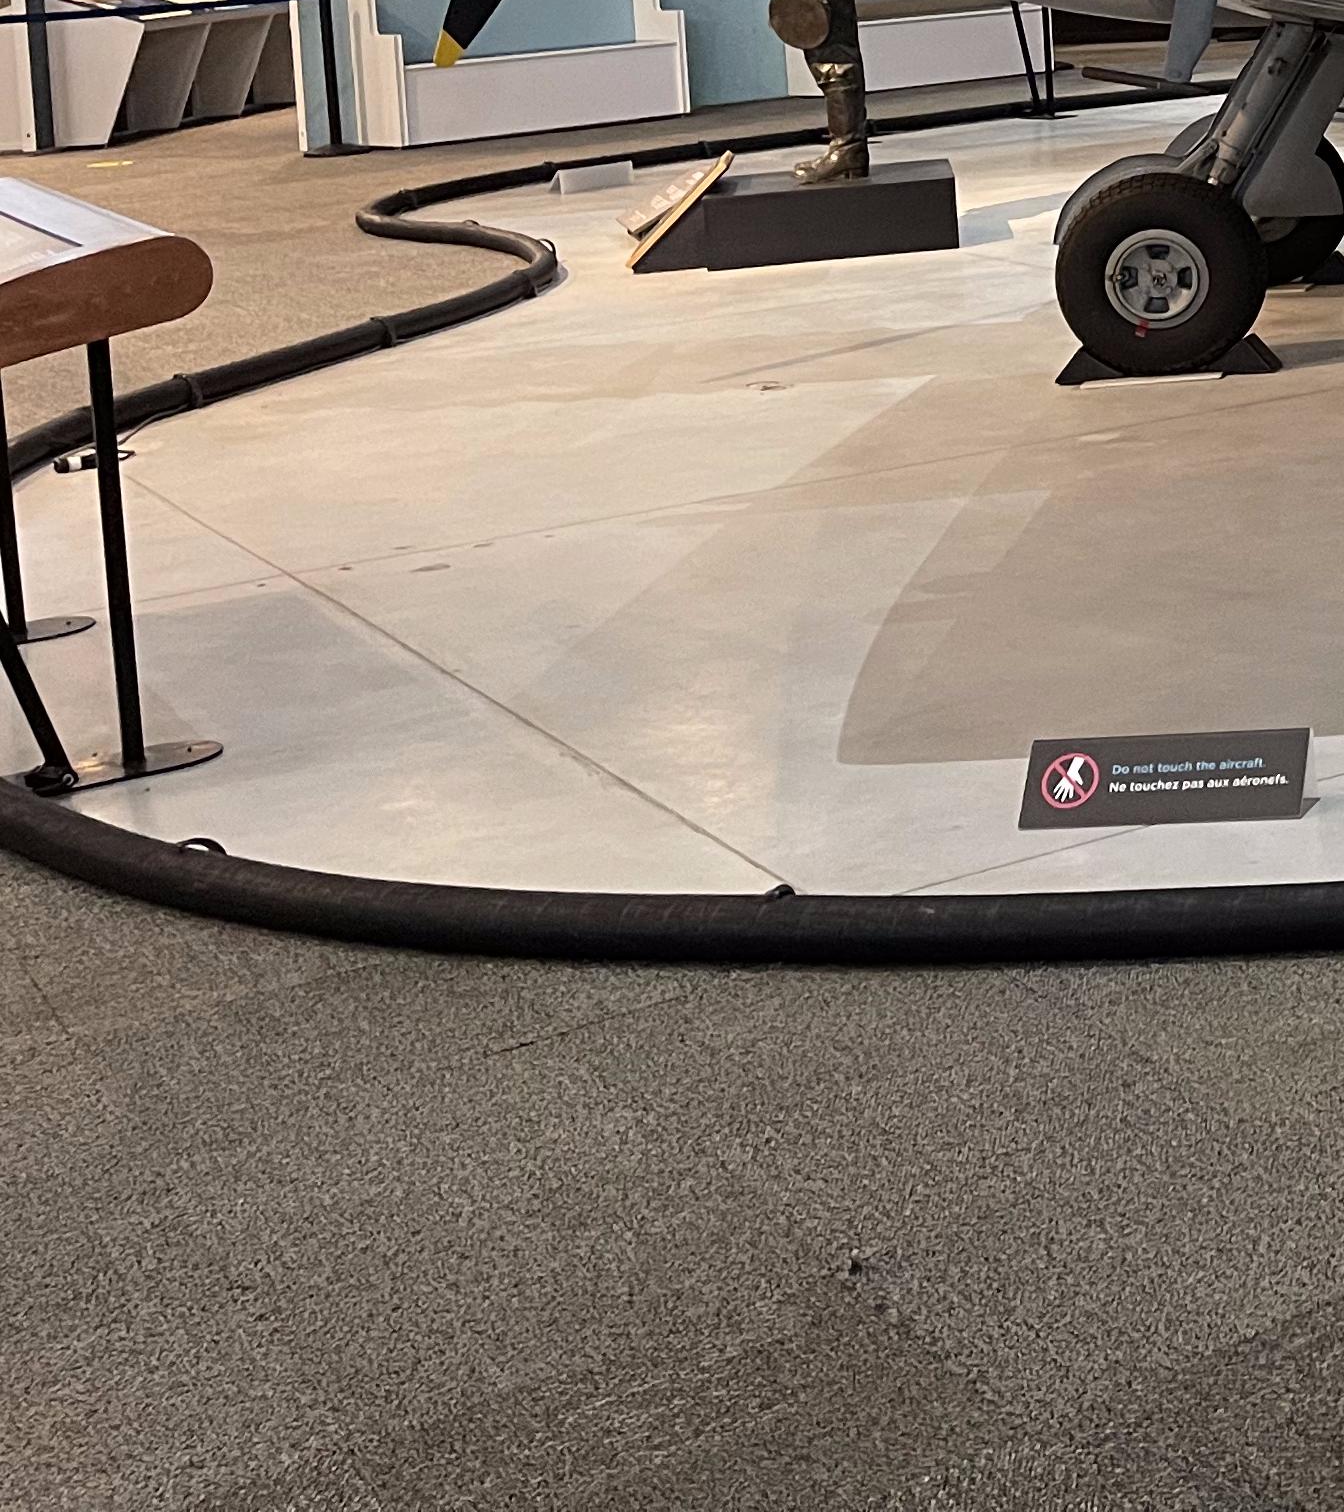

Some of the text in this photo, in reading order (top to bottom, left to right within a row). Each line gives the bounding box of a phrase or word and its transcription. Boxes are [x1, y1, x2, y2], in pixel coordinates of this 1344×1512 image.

[1112, 757, 1265, 775] Do not touch the aircraft.
[1109, 782, 1126, 793] Ne
[1130, 779, 1179, 792] touchez
[1182, 779, 1204, 791] pas
[1206, 777, 1229, 789] aux
